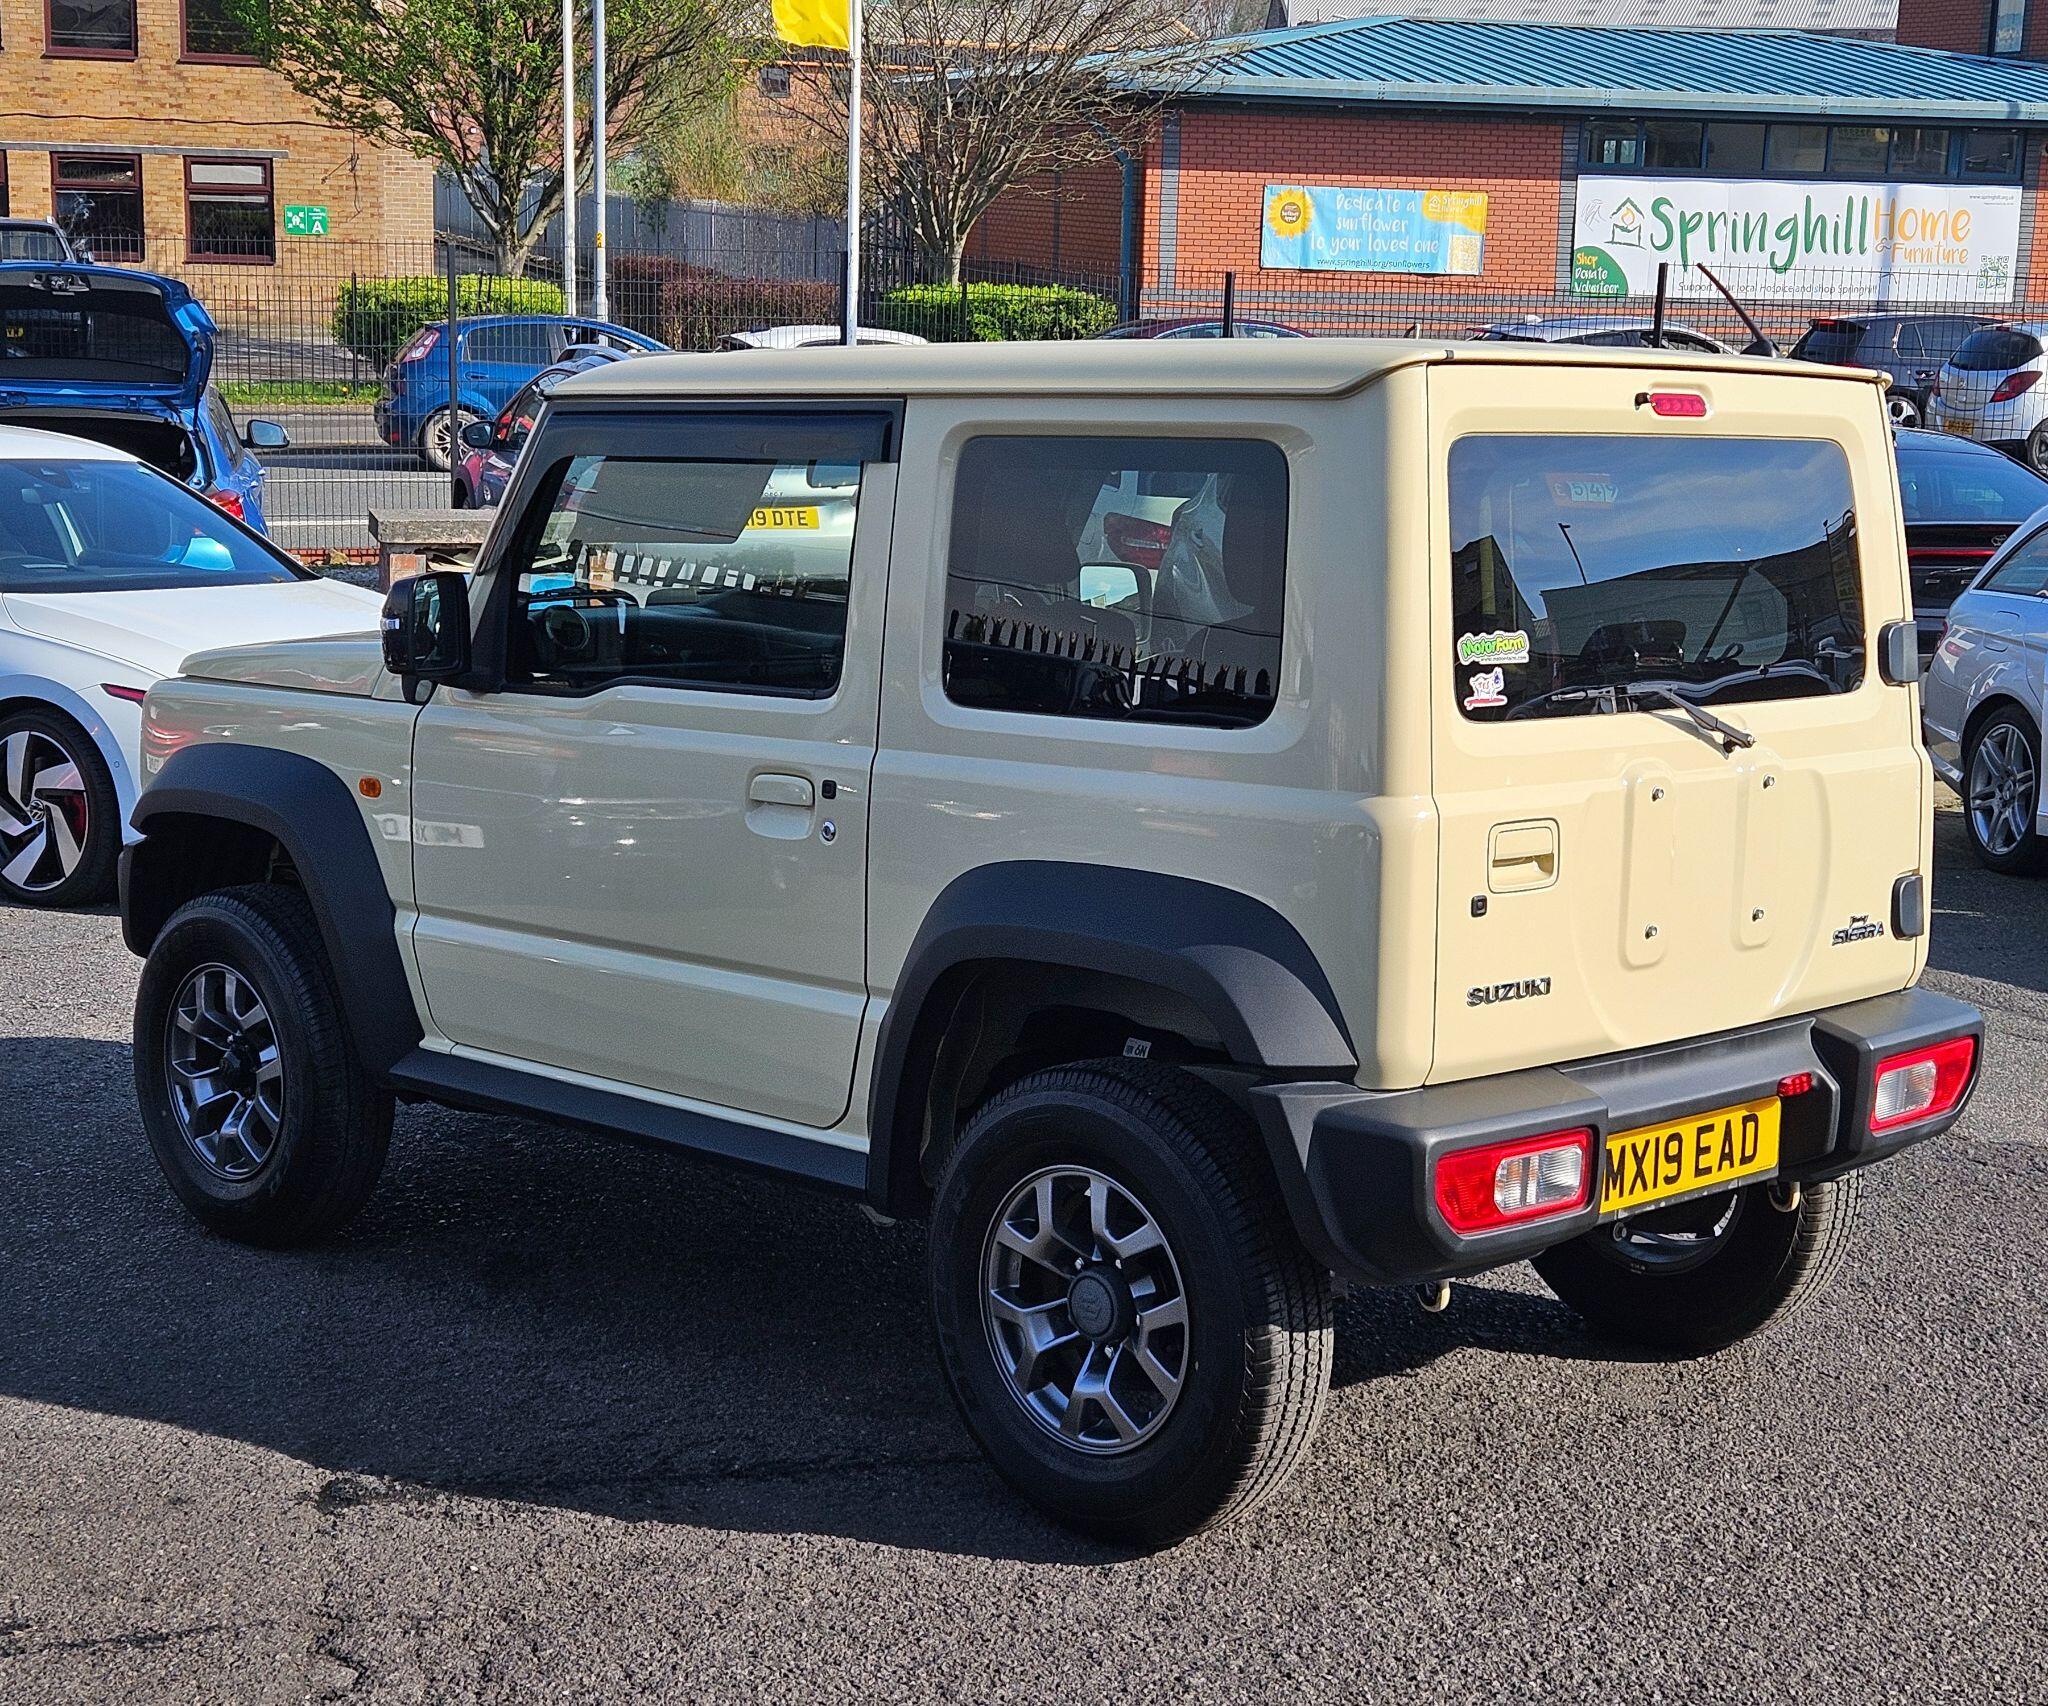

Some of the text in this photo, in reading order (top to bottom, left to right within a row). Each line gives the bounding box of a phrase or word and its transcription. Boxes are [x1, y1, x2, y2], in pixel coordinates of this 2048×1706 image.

[1336, 192, 1416, 213] Dedicate a
[311, 220, 325, 235] A
[1336, 212, 1409, 233] sunflower
[1329, 236, 1362, 256] your
[1368, 232, 1410, 252] loved
[1414, 238, 1440, 253] one
[1650, 194, 1971, 275] Springhill Home
[1576, 252, 1599, 269] Shop
[1875, 236, 1969, 265] & Furniture
[1317, 258, 1430, 269] www.springhill.org/sunflowers
[1575, 266, 1608, 281] Donate
[1679, 282, 1713, 295] Support
[746, 510, 809, 527] 19 DTE
[1831, 921, 1885, 947] SIERRA
[1466, 976, 1552, 1008] SUZUKI
[1603, 1112, 1760, 1203] MX19 EAD
